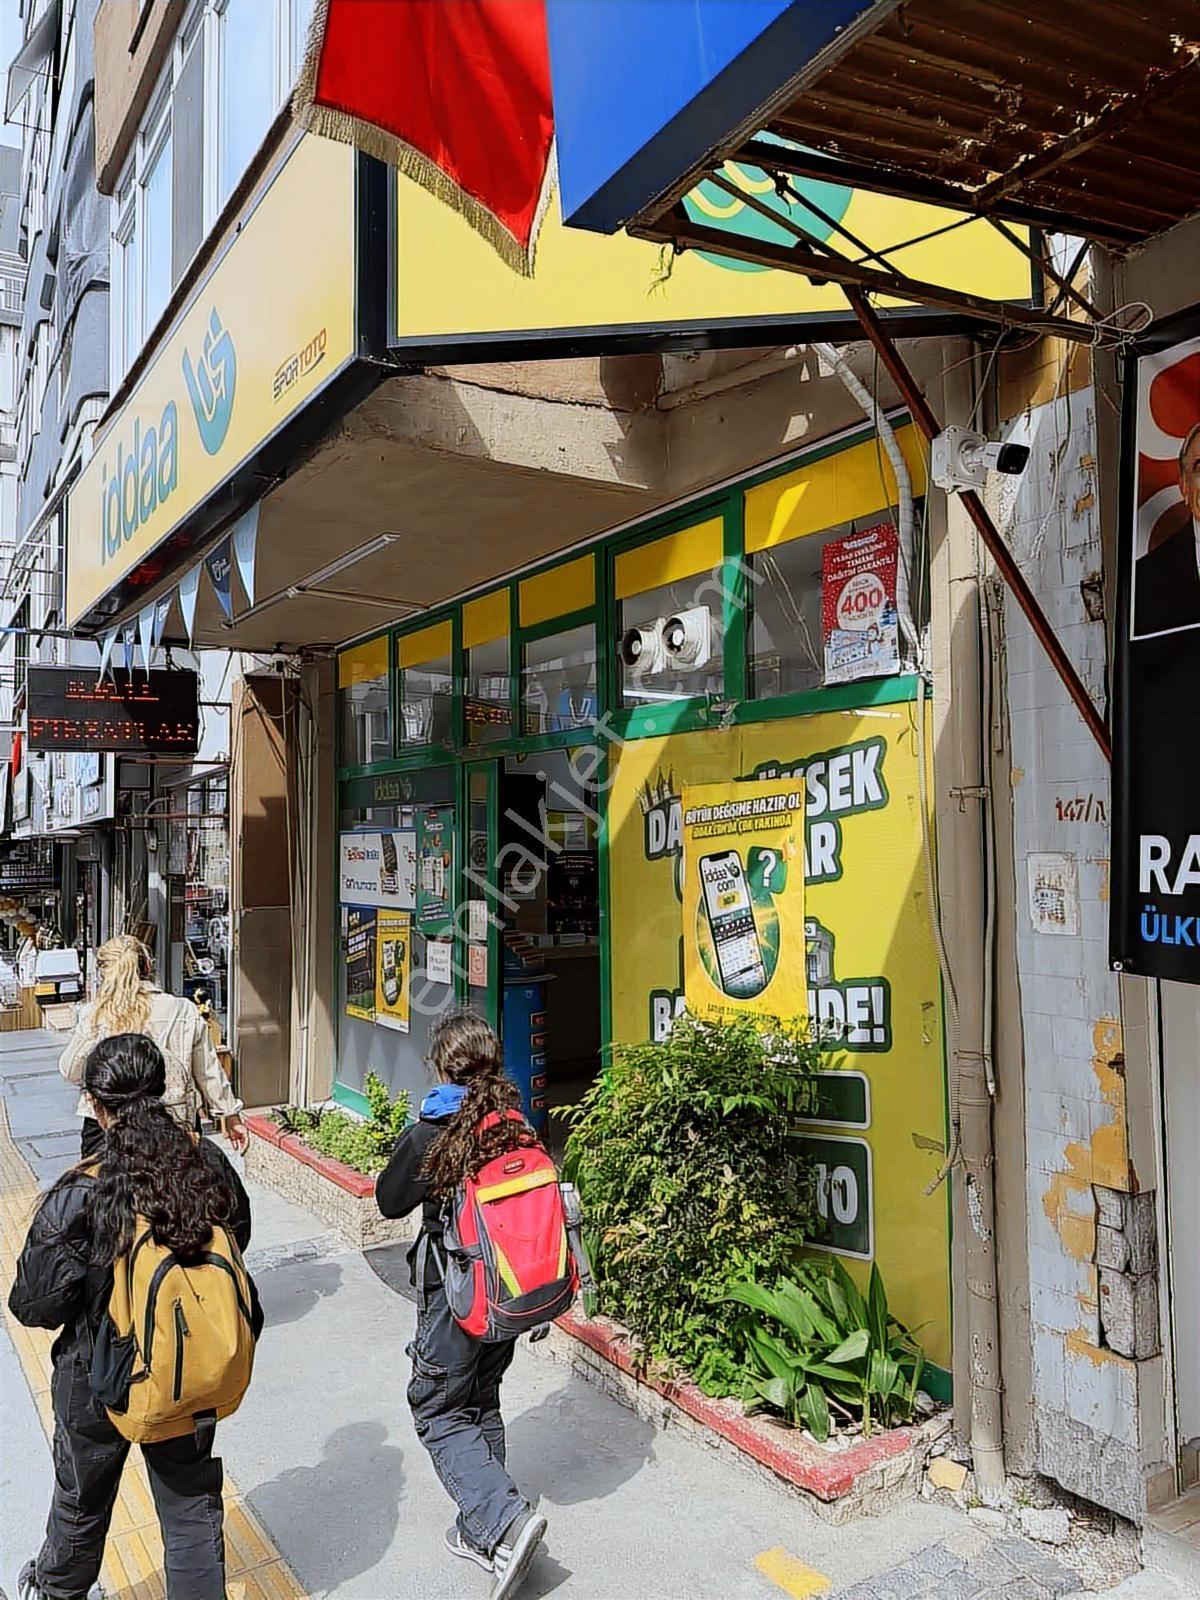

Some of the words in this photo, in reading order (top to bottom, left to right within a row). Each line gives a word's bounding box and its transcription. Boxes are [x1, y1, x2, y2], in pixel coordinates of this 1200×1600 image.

[101, 400, 178, 566] iddaa
[841, 588, 883, 615] 400
[752, 795, 787, 815] HAZIR
[788, 793, 801, 809] OL
